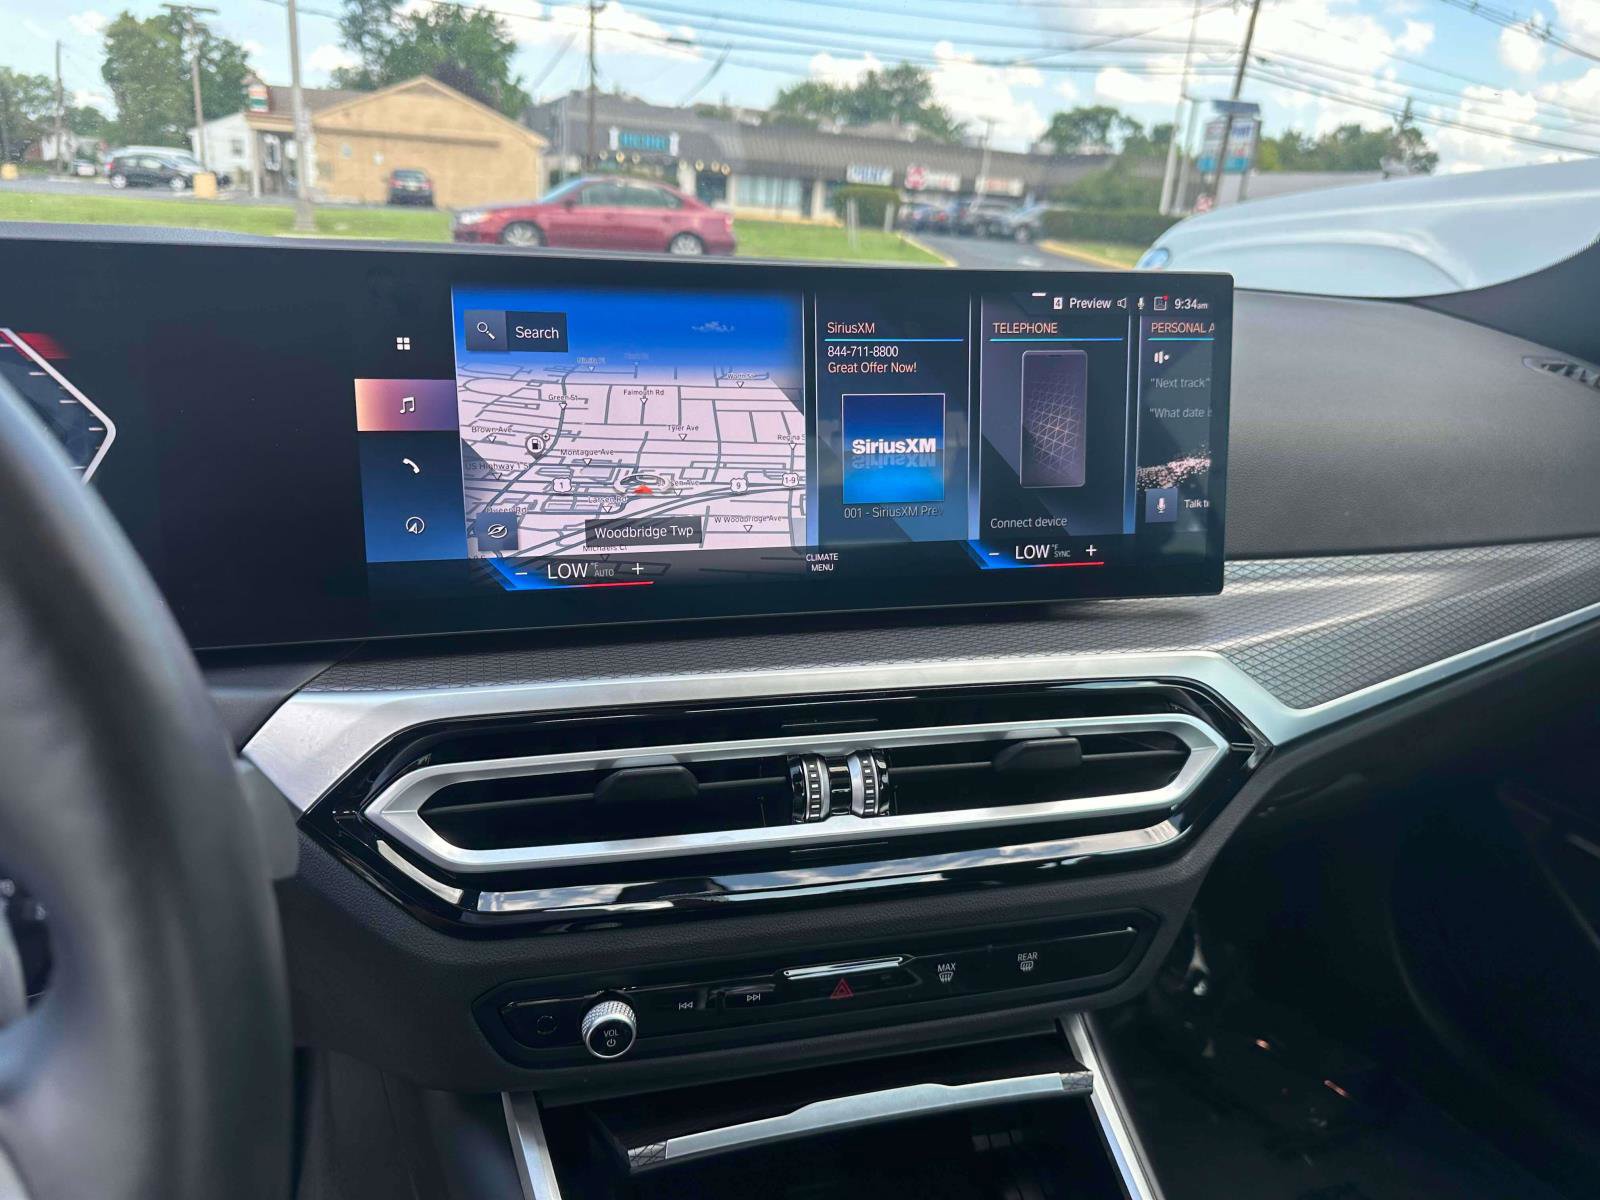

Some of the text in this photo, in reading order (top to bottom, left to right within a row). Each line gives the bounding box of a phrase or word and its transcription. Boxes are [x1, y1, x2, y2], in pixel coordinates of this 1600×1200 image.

[1070, 298, 1111, 309] Preview
[515, 325, 560, 340] Search
[827, 322, 875, 334] SiriusXM
[992, 322, 1058, 334] TELEPHONE
[1151, 322, 1206, 333] PERSONAL
[827, 345, 899, 357] 844-711-8800
[827, 361, 917, 373] Great Offer Now!
[623, 388, 665, 396] Falmouth Rd
[1182, 407, 1205, 418] date
[667, 425, 685, 433] Tyler
[851, 437, 937, 455] SiriusXM
[560, 448, 599, 457] Montague
[479, 462, 514, 471] Highway
[736, 481, 741, 489] 9
[1183, 499, 1202, 508] Talk
[844, 507, 862, 519] 001
[872, 506, 918, 518] SiriusXM
[723, 515, 767, 523] Woodbridge
[990, 516, 1068, 529] Connect device
[594, 525, 694, 539] Woodbridge Twp
[805, 553, 839, 562] CLIMATE
[1015, 544, 1050, 560] LOW
[1053, 550, 1071, 559] SYNC
[547, 563, 589, 579] LOW
[594, 569, 615, 577] AUTO
[811, 564, 834, 572] MENU
[1017, 951, 1038, 962] REAR
[937, 962, 956, 972] MAX
[603, 1028, 620, 1038] VOL
